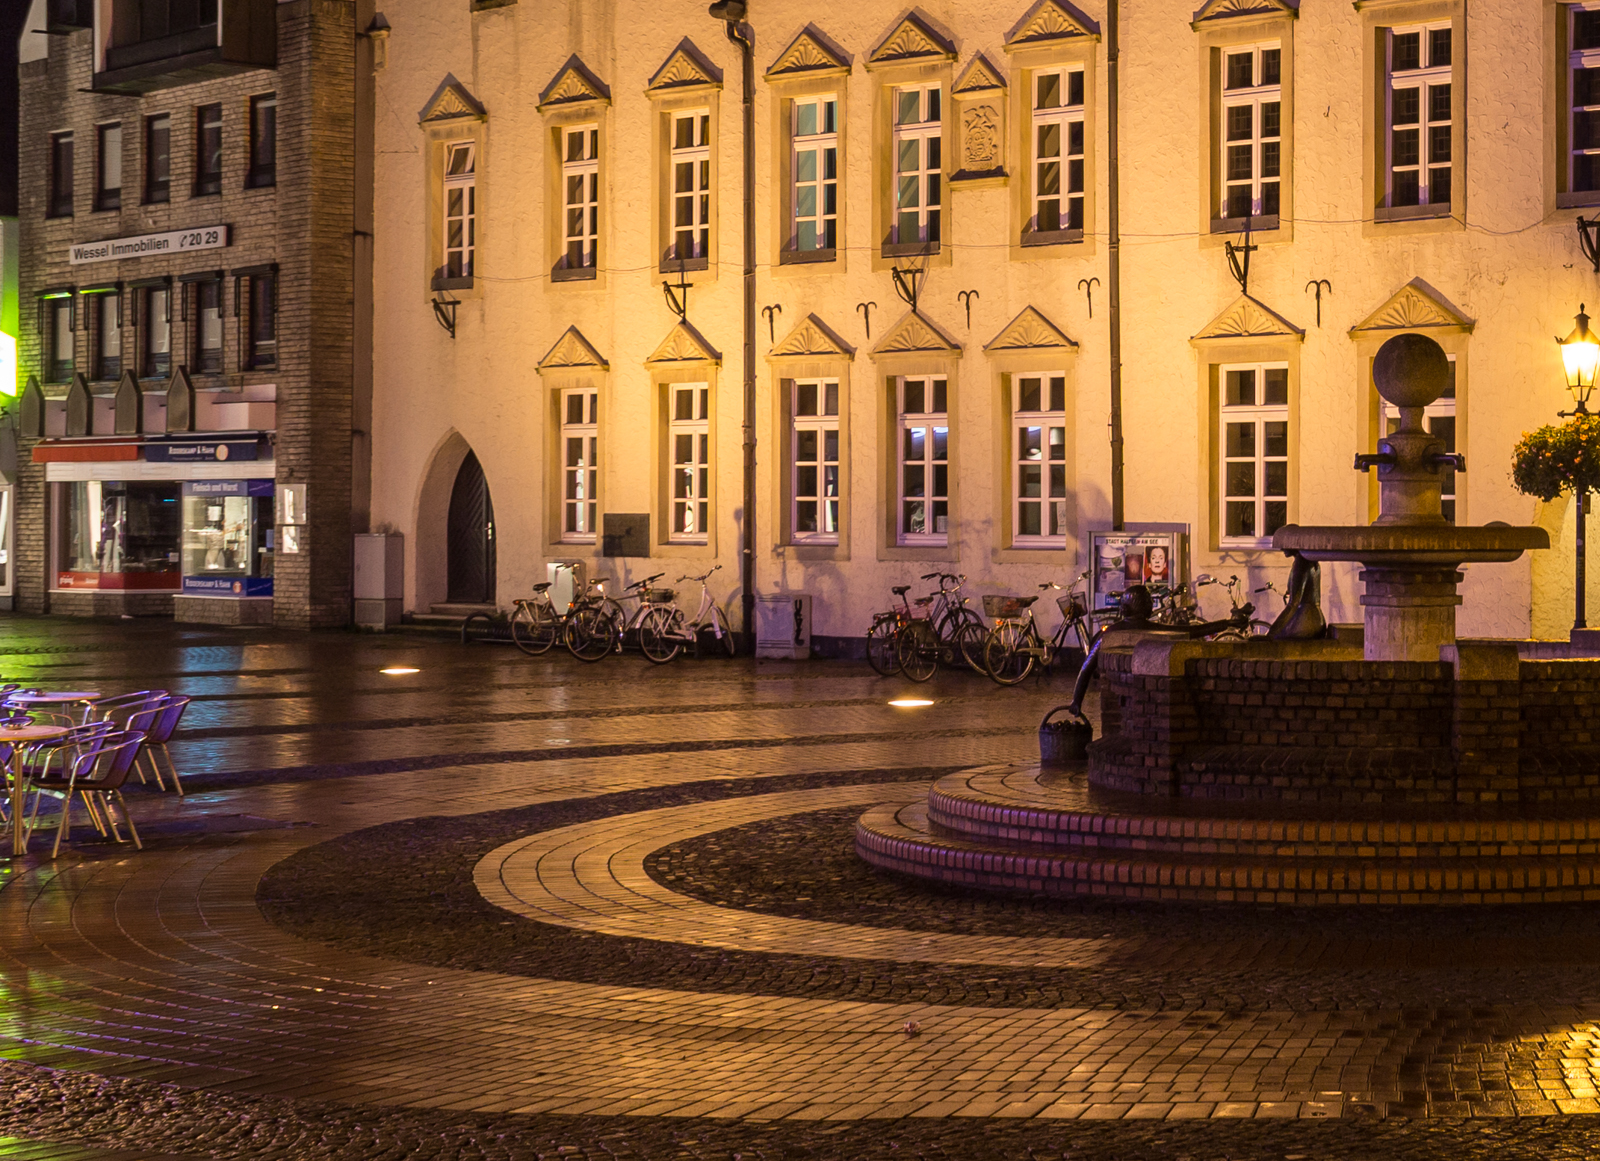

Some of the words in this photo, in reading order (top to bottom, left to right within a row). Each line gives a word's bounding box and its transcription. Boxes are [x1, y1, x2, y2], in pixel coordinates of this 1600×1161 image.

[73, 244, 109, 260] Wessel
[111, 237, 169, 256] Immobilien
[188, 233, 202, 246] 20
[205, 230, 219, 245] 29
[192, 483, 211, 492] Fleisch
[211, 483, 222, 492] und
[222, 483, 238, 492] Wurst
